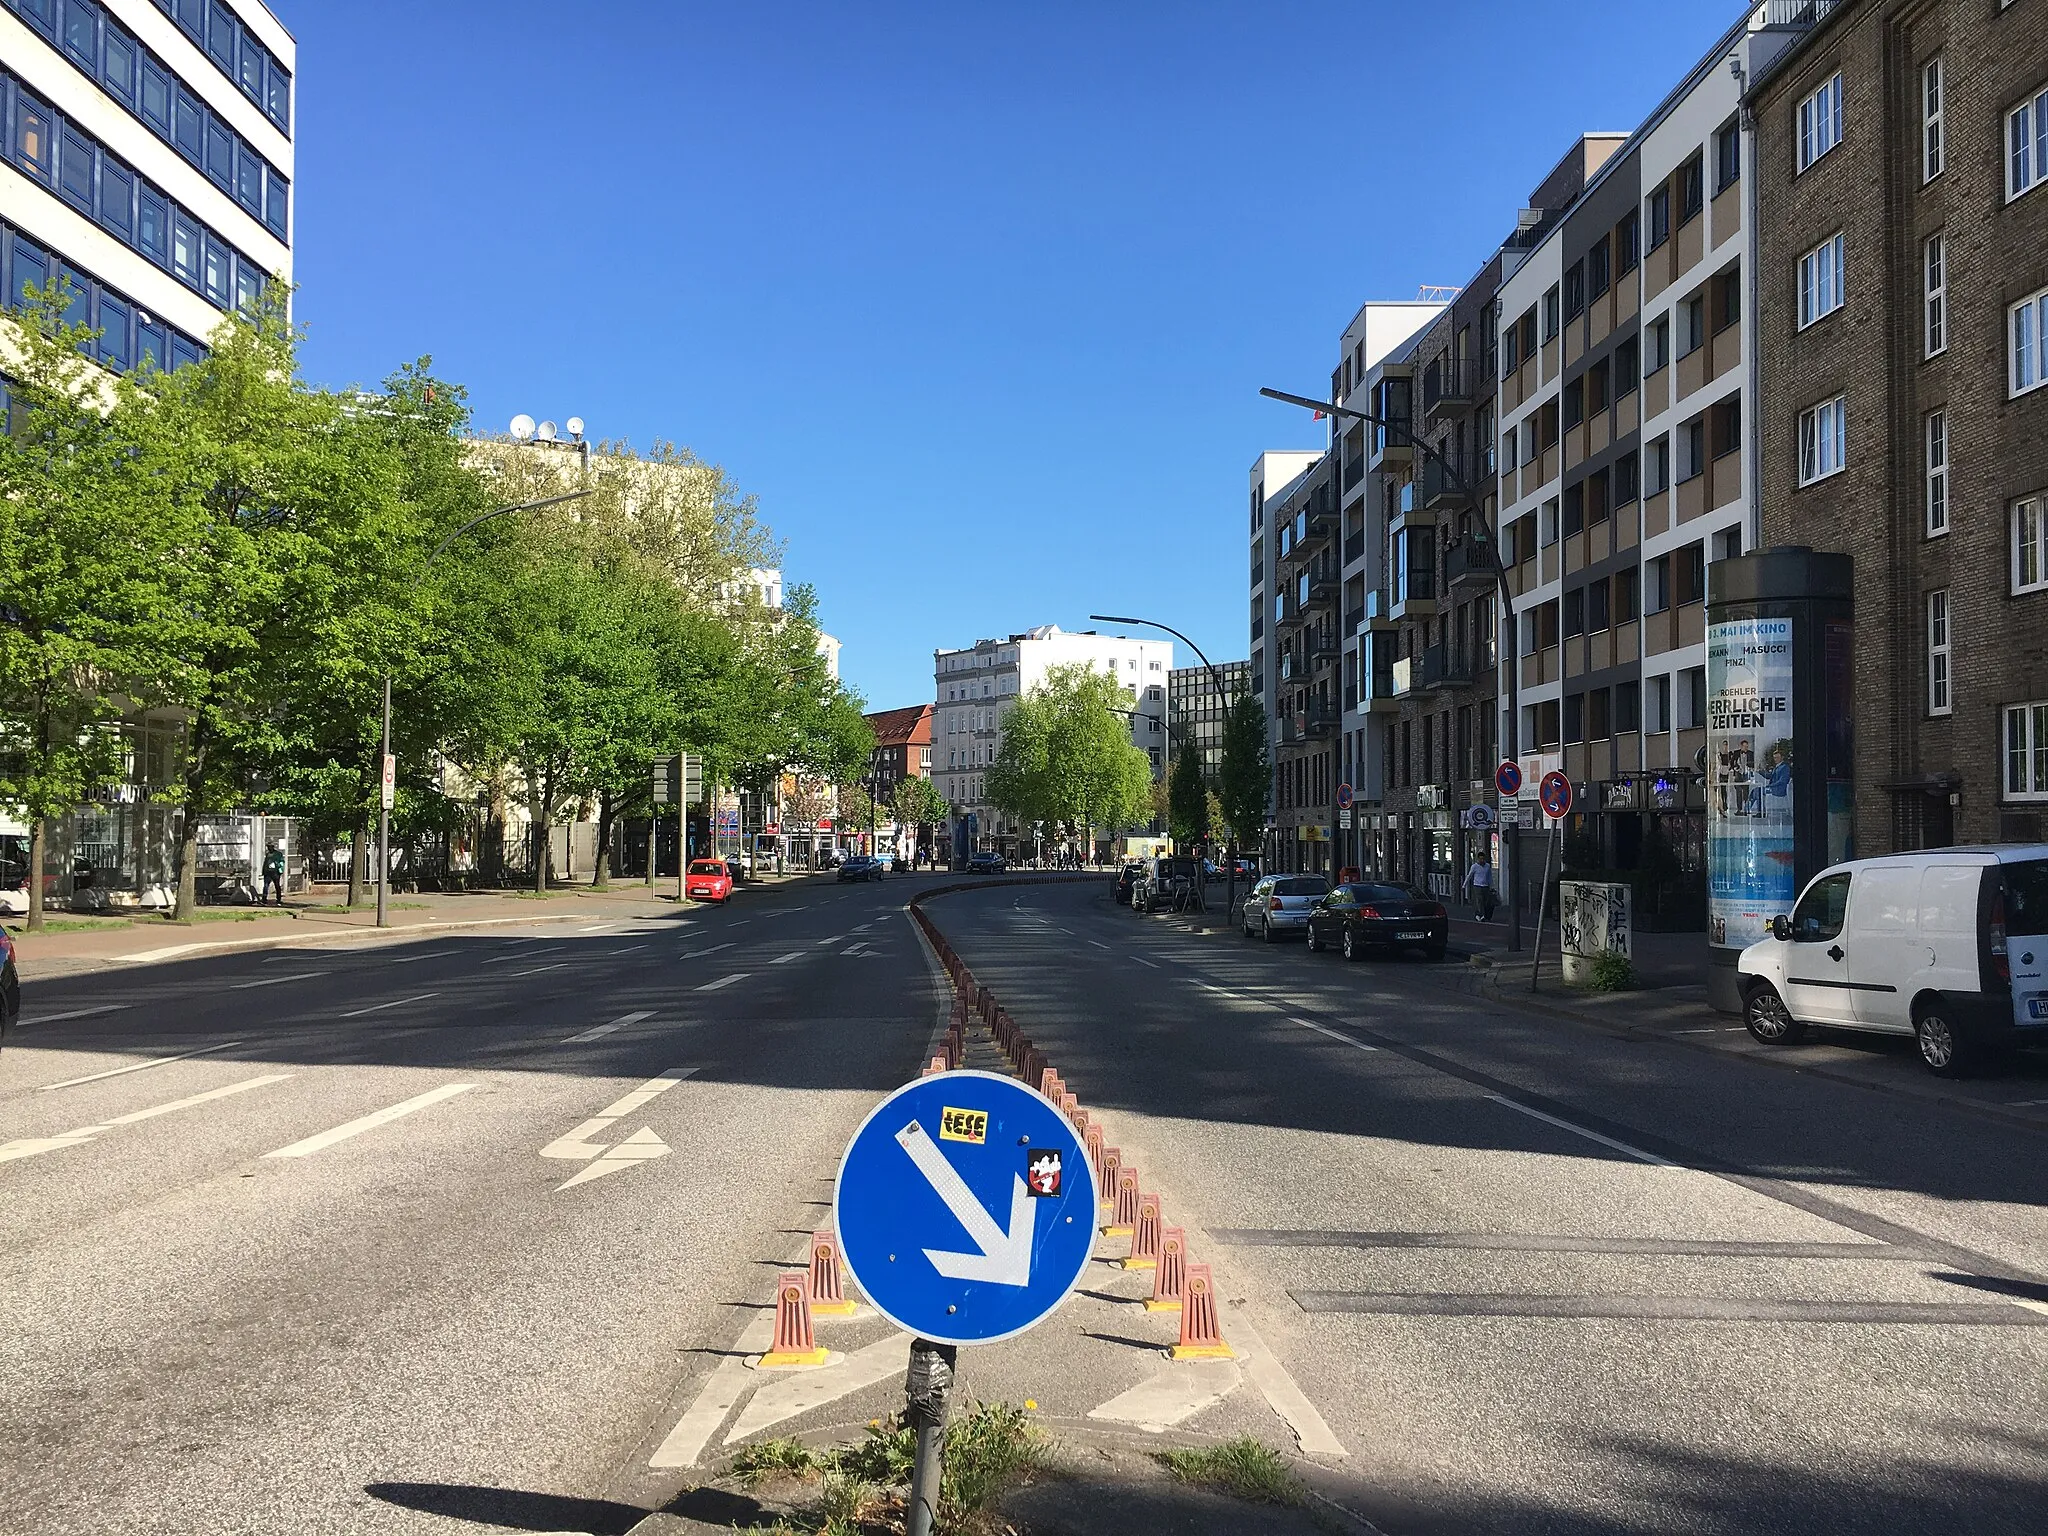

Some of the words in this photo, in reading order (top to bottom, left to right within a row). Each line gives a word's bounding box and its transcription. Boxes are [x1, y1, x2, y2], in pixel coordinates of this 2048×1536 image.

[1720, 626, 1736, 637] MAI
[1739, 625, 1752, 635] IM
[1757, 623, 1786, 634] KINO
[1743, 645, 1786, 655] MASUCCI
[1725, 657, 1746, 667] FINZI
[1720, 687, 1757, 697] ROEHLER
[1713, 713, 1765, 730] ZEITEN
